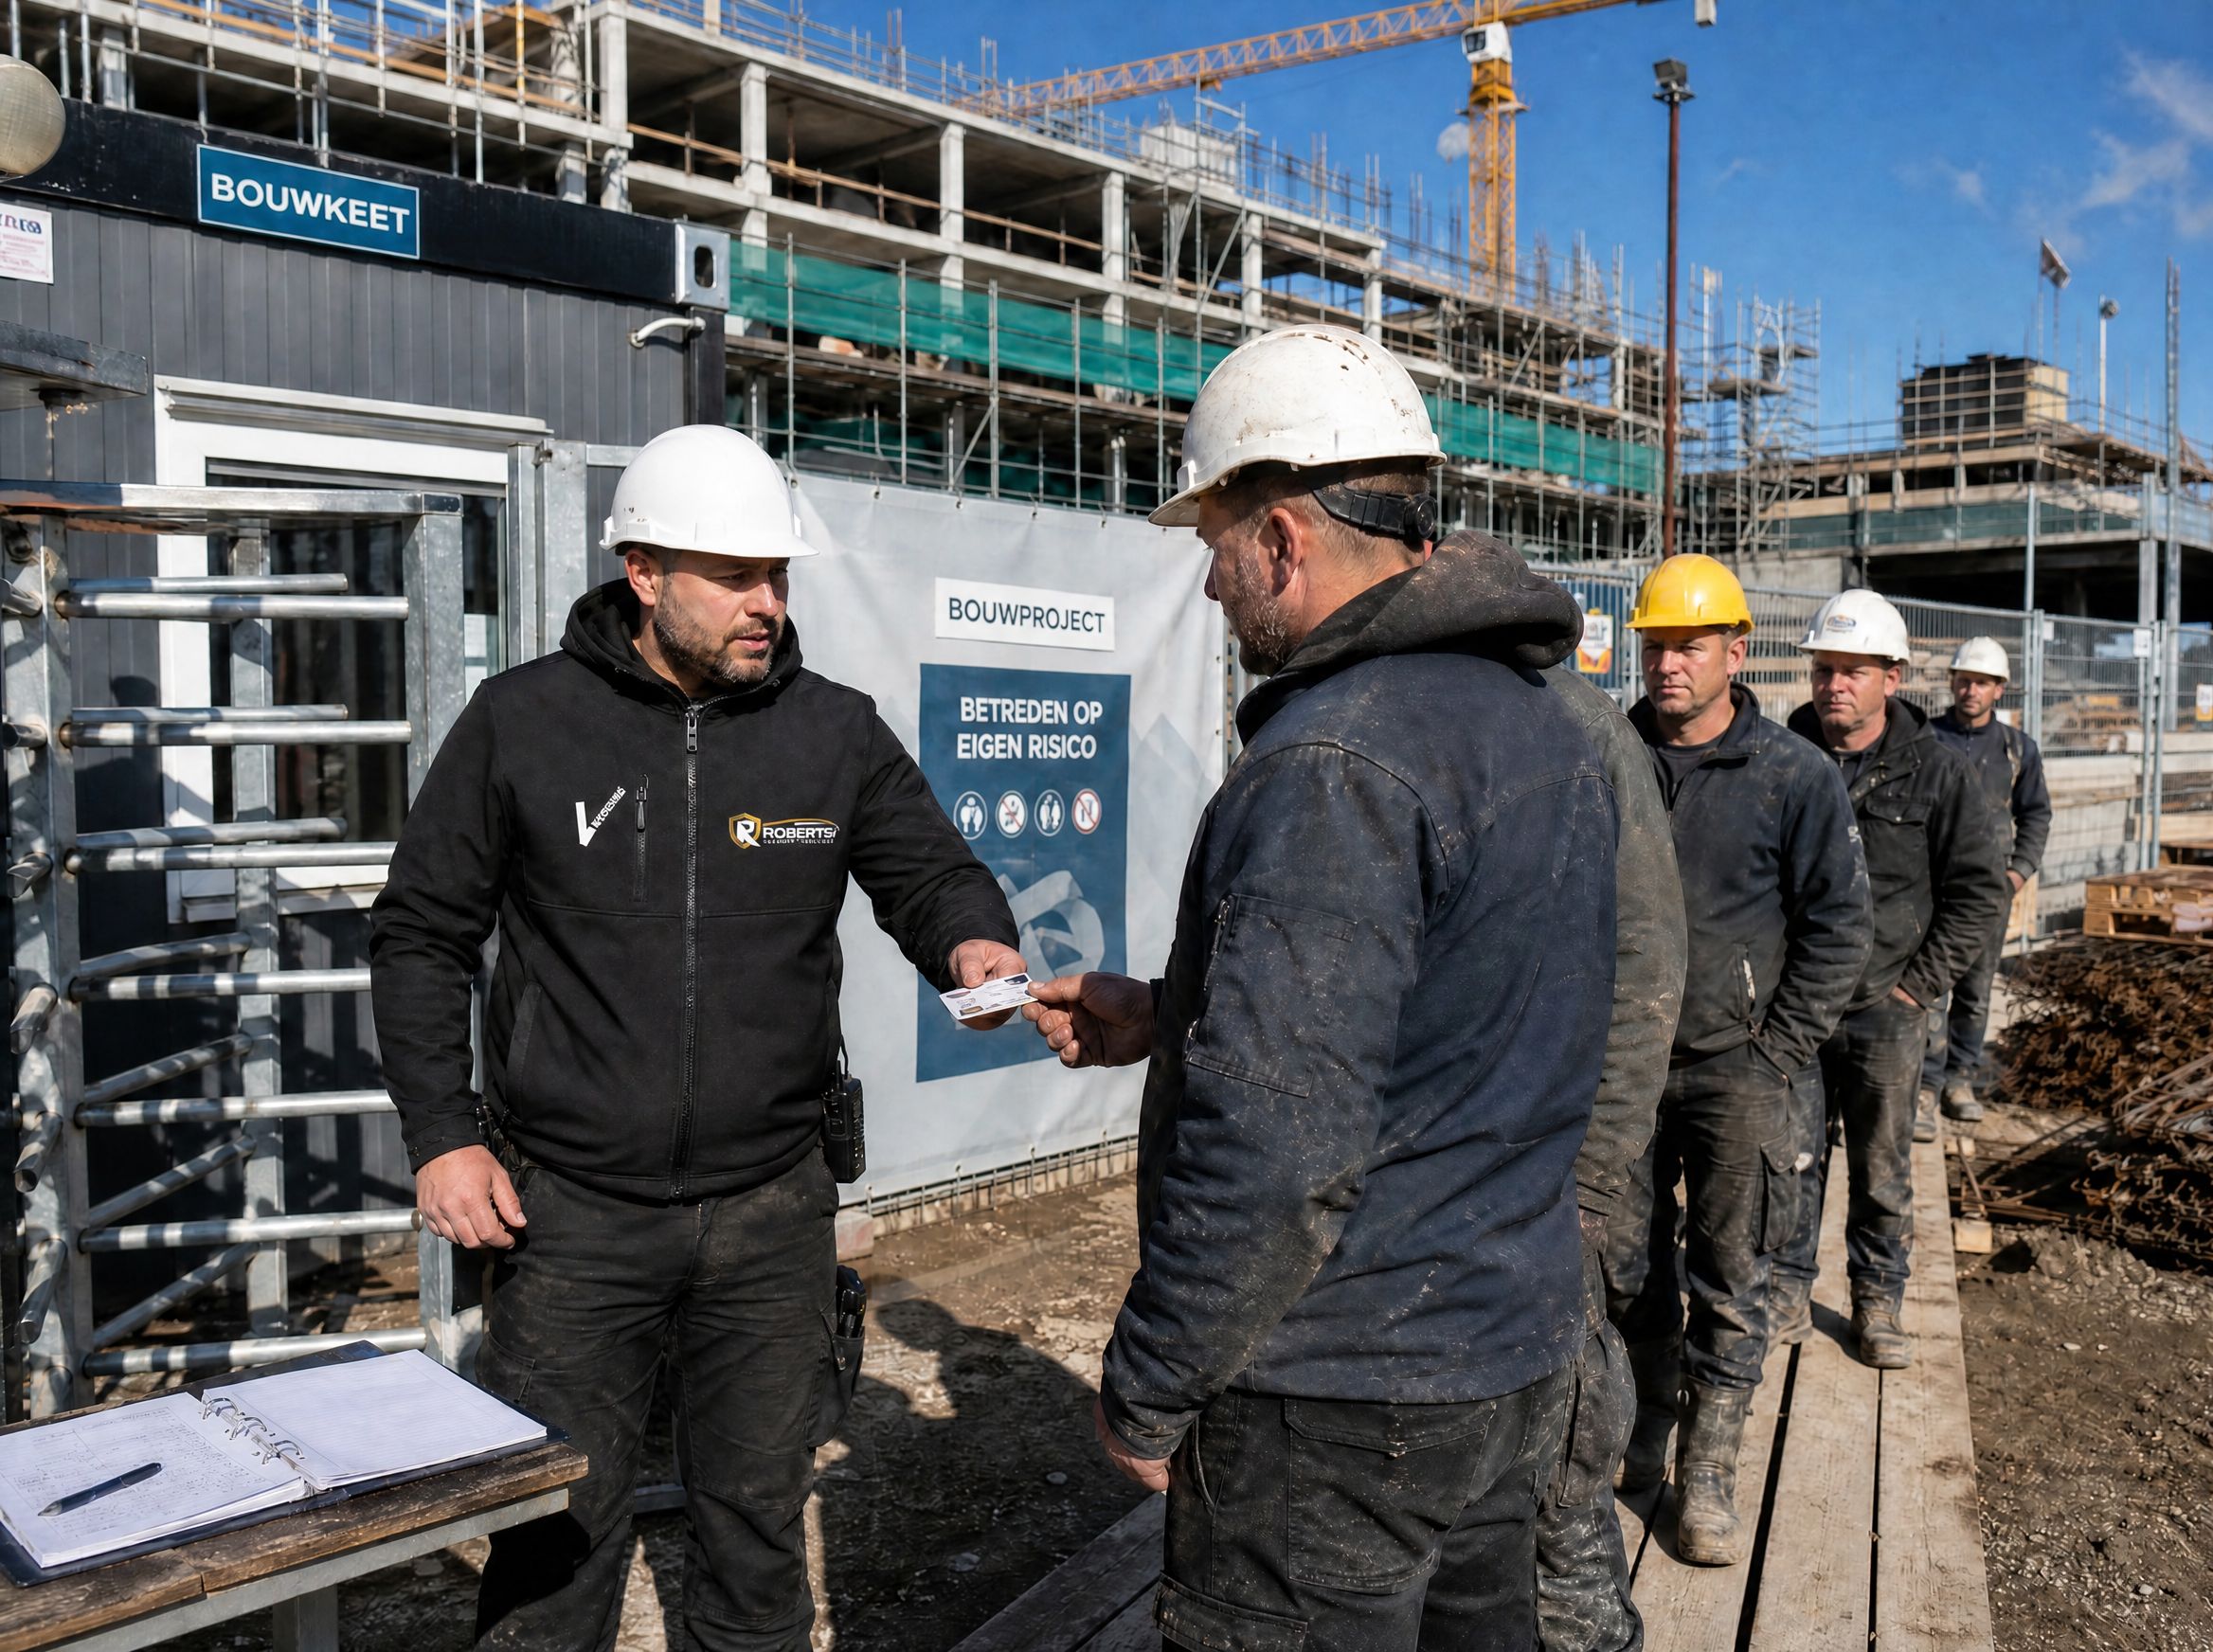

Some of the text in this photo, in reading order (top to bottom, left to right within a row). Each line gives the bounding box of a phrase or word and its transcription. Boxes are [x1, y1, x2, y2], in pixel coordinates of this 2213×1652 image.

[211, 172, 410, 234] BOUWKEET
[948, 597, 1106, 634] BOUWPROJECT
[960, 696, 1104, 725] BETREDEN OP
[956, 733, 1097, 760] EIGEN RISICO
[763, 827, 834, 839] ROBERTS
